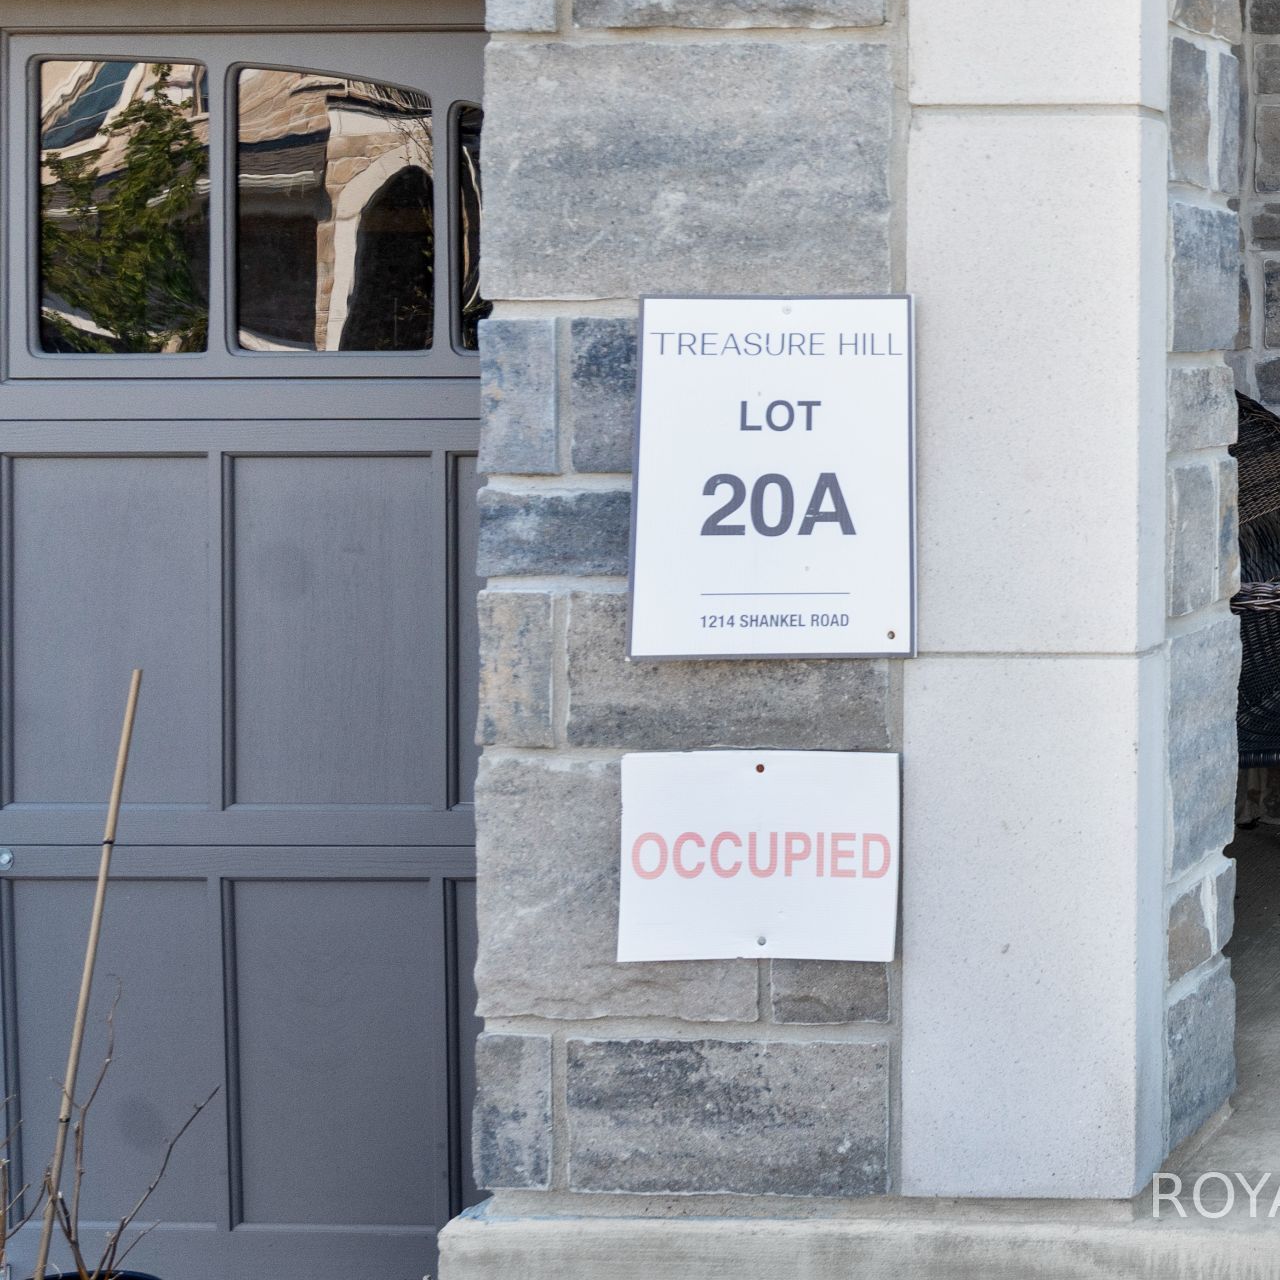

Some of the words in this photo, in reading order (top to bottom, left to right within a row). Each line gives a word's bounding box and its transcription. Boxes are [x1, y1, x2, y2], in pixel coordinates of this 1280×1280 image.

[650, 332, 825, 356] TREASURE
[839, 332, 903, 356] HILL
[740, 399, 822, 432] LOT
[700, 472, 857, 537] 20A
[700, 614, 735, 628] 1214
[739, 614, 806, 628] SHANKEL
[810, 613, 849, 627] ROAD
[630, 830, 892, 880] OCCUPIED
